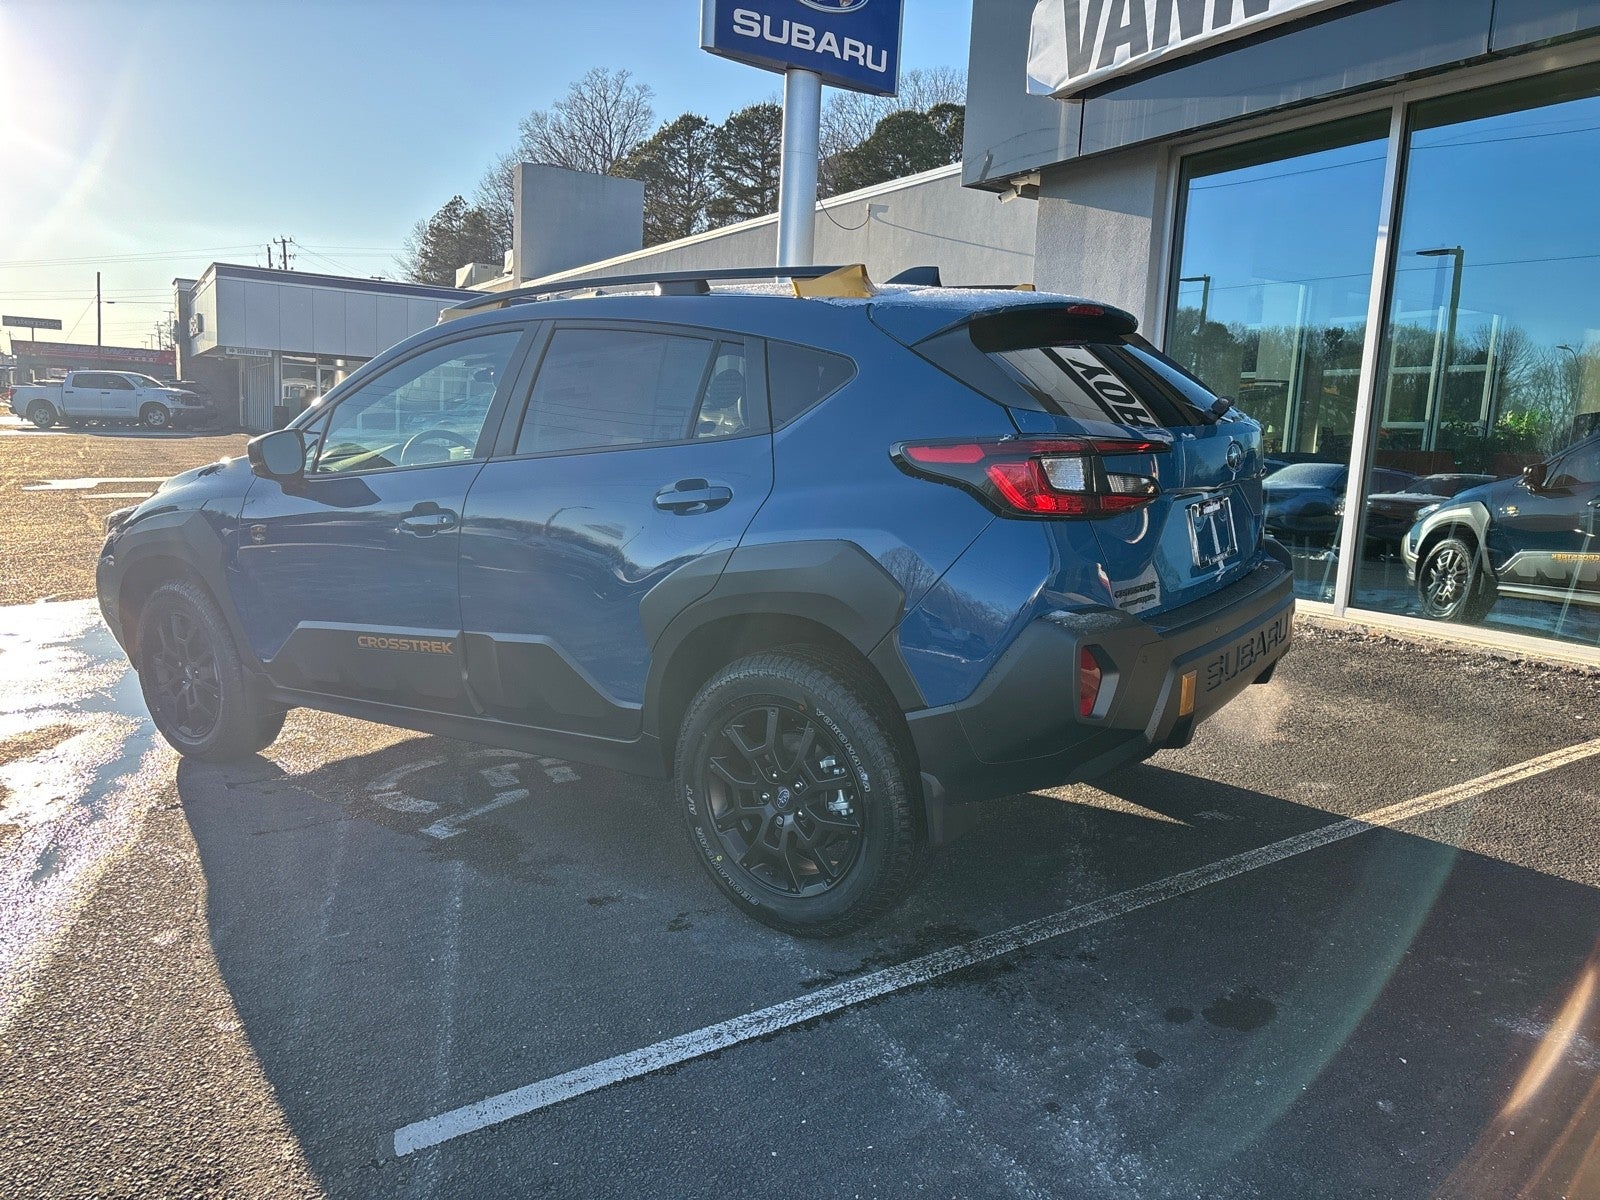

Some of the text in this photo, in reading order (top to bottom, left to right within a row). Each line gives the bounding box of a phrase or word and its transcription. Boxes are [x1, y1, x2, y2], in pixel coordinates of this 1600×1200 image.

[733, 8, 888, 73] SUBARU
[1064, 0, 1271, 80] VAN
[357, 636, 454, 654] CROSSTREK
[1207, 613, 1289, 692] SUBARU
[816, 708, 871, 792] YOKOHAMA
[695, 826, 759, 906] GEOLANDAR
